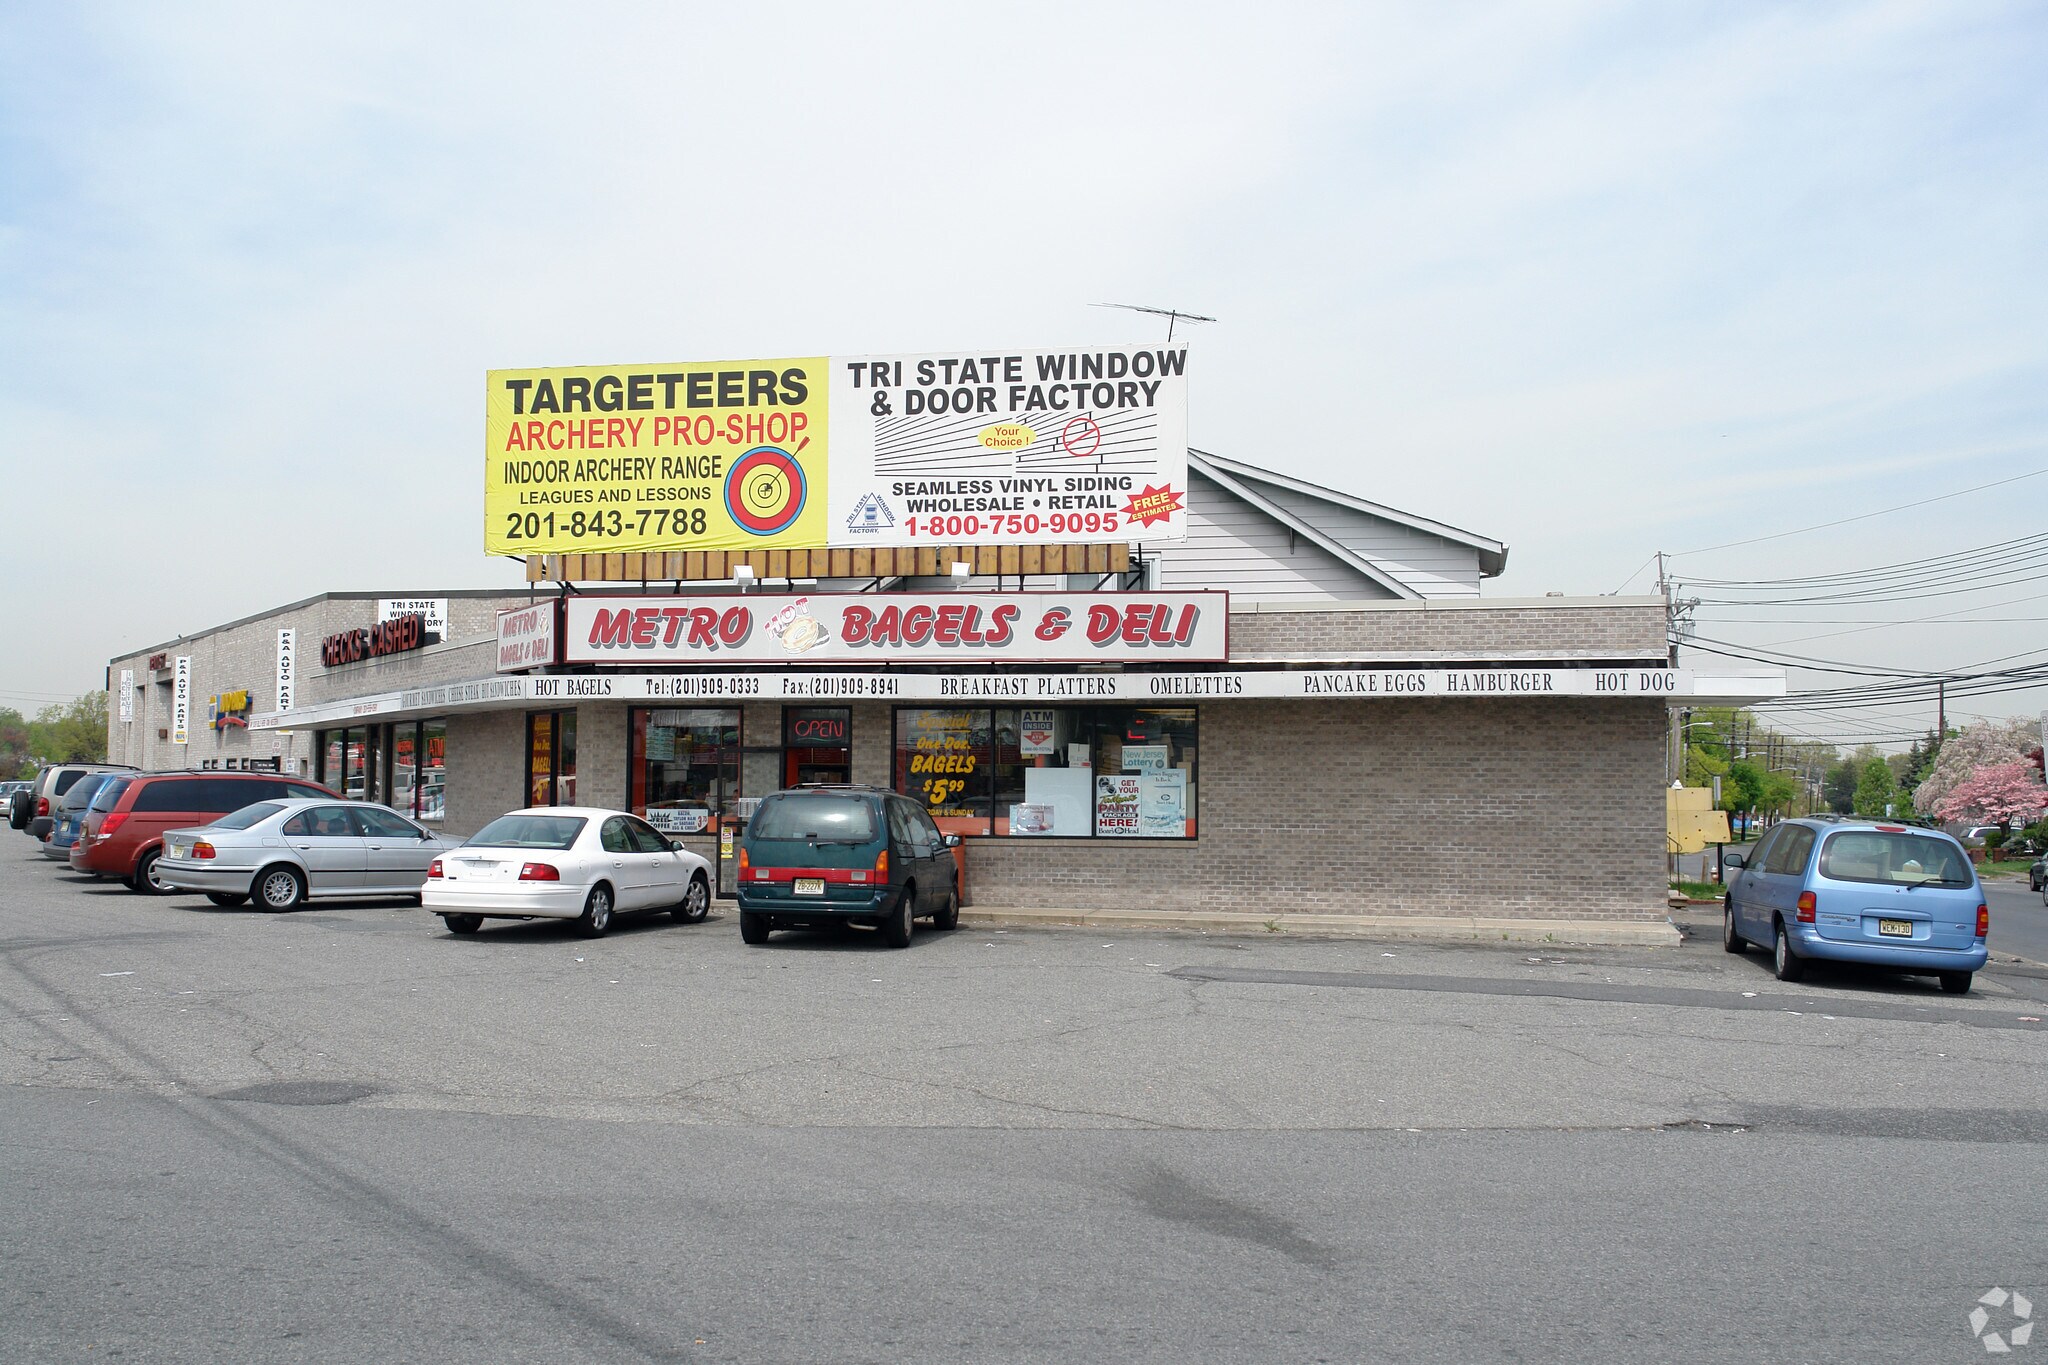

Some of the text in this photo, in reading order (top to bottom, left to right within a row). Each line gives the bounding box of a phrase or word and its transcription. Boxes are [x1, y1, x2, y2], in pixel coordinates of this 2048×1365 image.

[848, 349, 1188, 388] TRI STATE WINDOW
[506, 368, 809, 415] TARGETEERS
[871, 380, 1162, 417] & DOOR FACTORY
[506, 412, 808, 451] ARCHERY PRO-SHOP
[994, 427, 1020, 436] Your
[985, 437, 1023, 447] Choice
[504, 455, 722, 484] INDOOR ARCHERY RANGE
[520, 486, 712, 505] LEAGUES AND LESSONS
[892, 476, 1133, 496] SEAMLESS VINYL SIDING
[906, 494, 1117, 514] WHOLESALE RETAIL
[1133, 491, 1170, 511] FREE
[1132, 503, 1177, 520] ESTIMATES
[506, 507, 707, 539] 201-843-7788
[904, 512, 1119, 537] 1-800-750-9095
[409, 601, 435, 609] STATE
[503, 610, 537, 638] METRO
[587, 604, 1201, 650] METRO BAGELS & DELI
[764, 597, 809, 640] HOT
[282, 632, 290, 651] P&A
[321, 614, 419, 667] CHECKS CASHED
[500, 642, 524, 666] BAGELS
[532, 637, 548, 661] DELI
[281, 656, 290, 680] AUTO
[178, 679, 186, 699] AUTO
[535, 680, 561, 696] HOT
[567, 679, 611, 696] BAGELS
[941, 678, 1029, 695] BREAKFAST
[1037, 677, 1116, 695] PLATTERS
[1150, 676, 1242, 694] OMELETTES
[1304, 674, 1377, 693] PANCAKE
[1384, 673, 1426, 692] EGGS
[1447, 673, 1553, 691] HAMBURGER
[1595, 673, 1629, 690] HOT
[1640, 673, 1675, 691] DOG
[177, 703, 185, 729] PARTS
[917, 712, 971, 731] Special
[1023, 711, 1053, 721] ATM
[1024, 722, 1051, 730] INSIDE
[794, 720, 843, 738] OPEN
[917, 736, 940, 749] One
[532, 756, 551, 773] BAGEL
[911, 755, 976, 773] BAGELS
[1142, 751, 1166, 759] Jersey
[1098, 804, 1140, 813] PARTY
